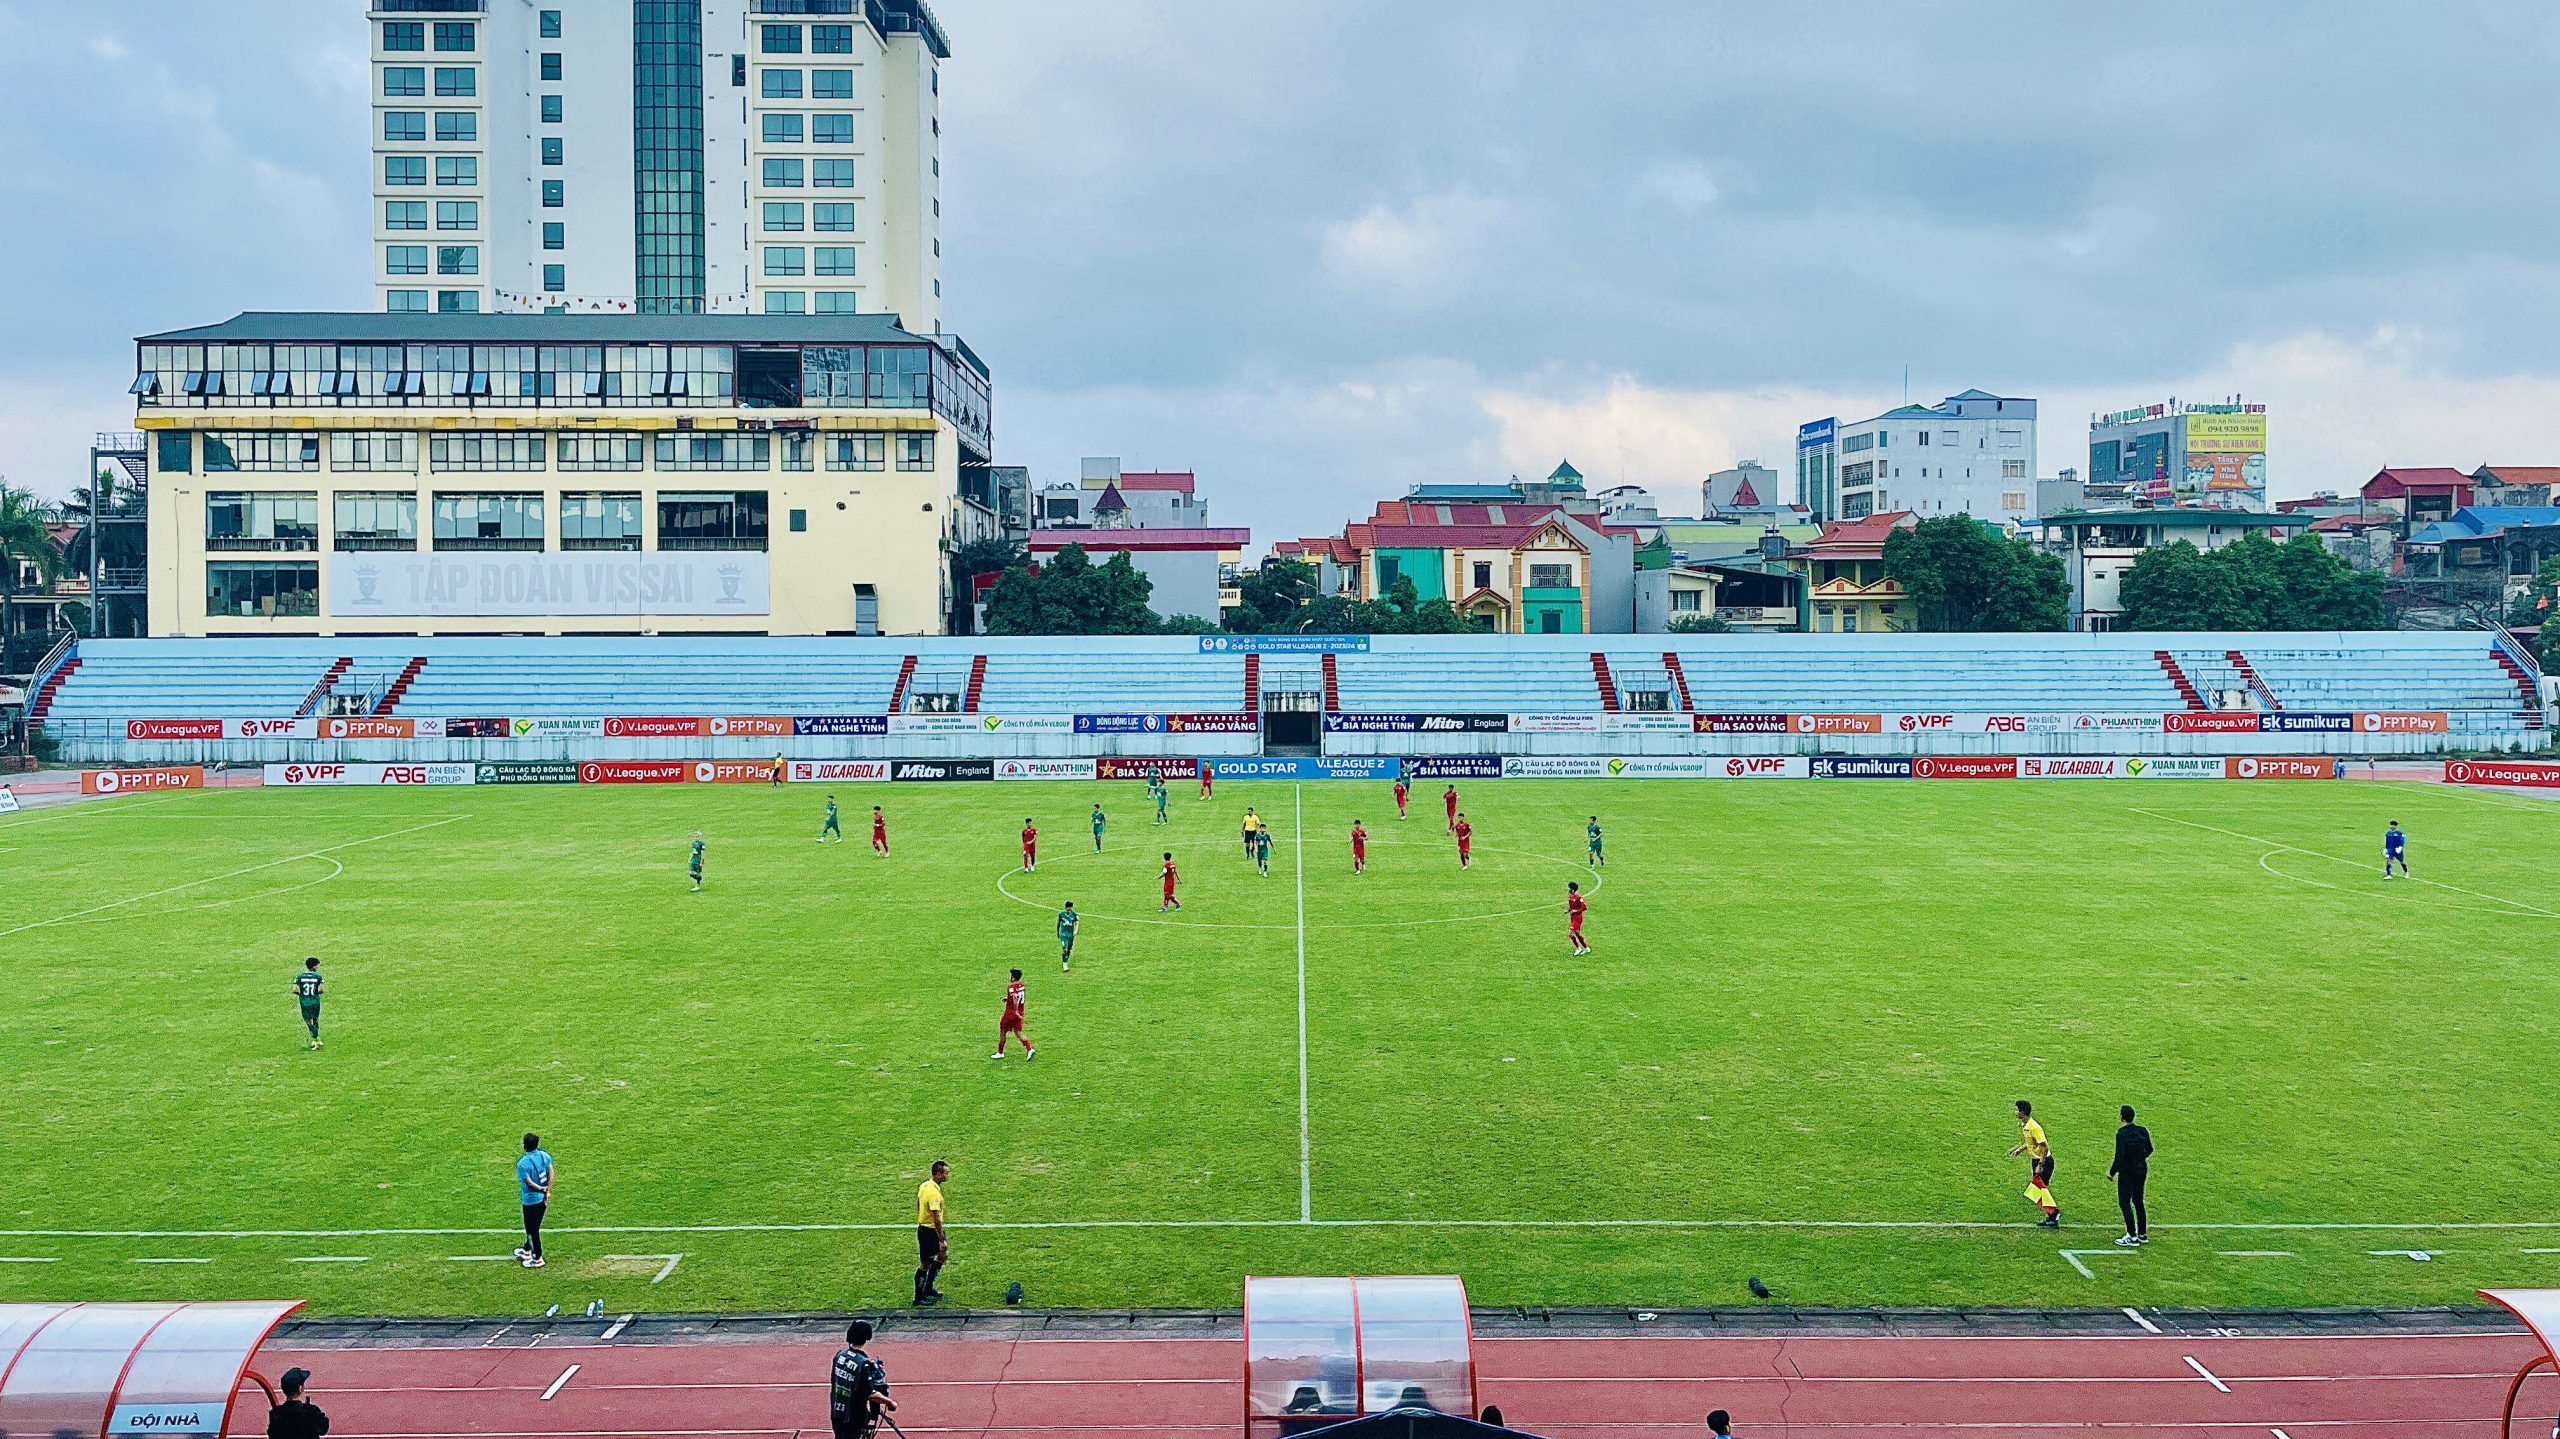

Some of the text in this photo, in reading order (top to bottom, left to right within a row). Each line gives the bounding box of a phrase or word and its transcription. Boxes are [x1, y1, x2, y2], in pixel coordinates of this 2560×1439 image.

[406, 555, 693, 610] TẬP ĐOÀN VISSAI
[260, 720, 295, 732] VPF
[562, 720, 577, 728] NAM
[583, 720, 600, 728] VIET
[730, 720, 782, 734] FPT Play
[1227, 721, 1256, 730] VÀNG
[1421, 717, 1504, 729] Mitre England
[1756, 721, 1786, 730] VÀNG
[1818, 719, 1870, 732] FPT Play
[1918, 715, 1953, 727] VPF
[2262, 717, 2350, 729] sk sumikura
[2384, 717, 2436, 731] FPT Play
[350, 722, 402, 736] FPT Play
[1219, 763, 1297, 773] GOLD STAR
[1316, 760, 1385, 768] V.LEAGUE 2
[1746, 759, 1785, 771] VPF
[1813, 759, 1909, 773] sk sumikura
[2045, 761, 2113, 774] JOGARBOLA
[2152, 761, 2220, 769] XUAN NAM VIET
[2261, 762, 2320, 777] FPT Play
[306, 765, 345, 779] VPF
[717, 766, 775, 780] FPT Play
[816, 765, 884, 778] JOGARBOLA
[897, 765, 989, 778] Mitre England
[1164, 766, 1195, 776] VÀNG
[1421, 767, 1438, 775] BIA
[121, 772, 190, 788] FPT Play
[303, 984, 314, 995] 31
[130, 1412, 199, 1428] ĐỘI NHÀ
